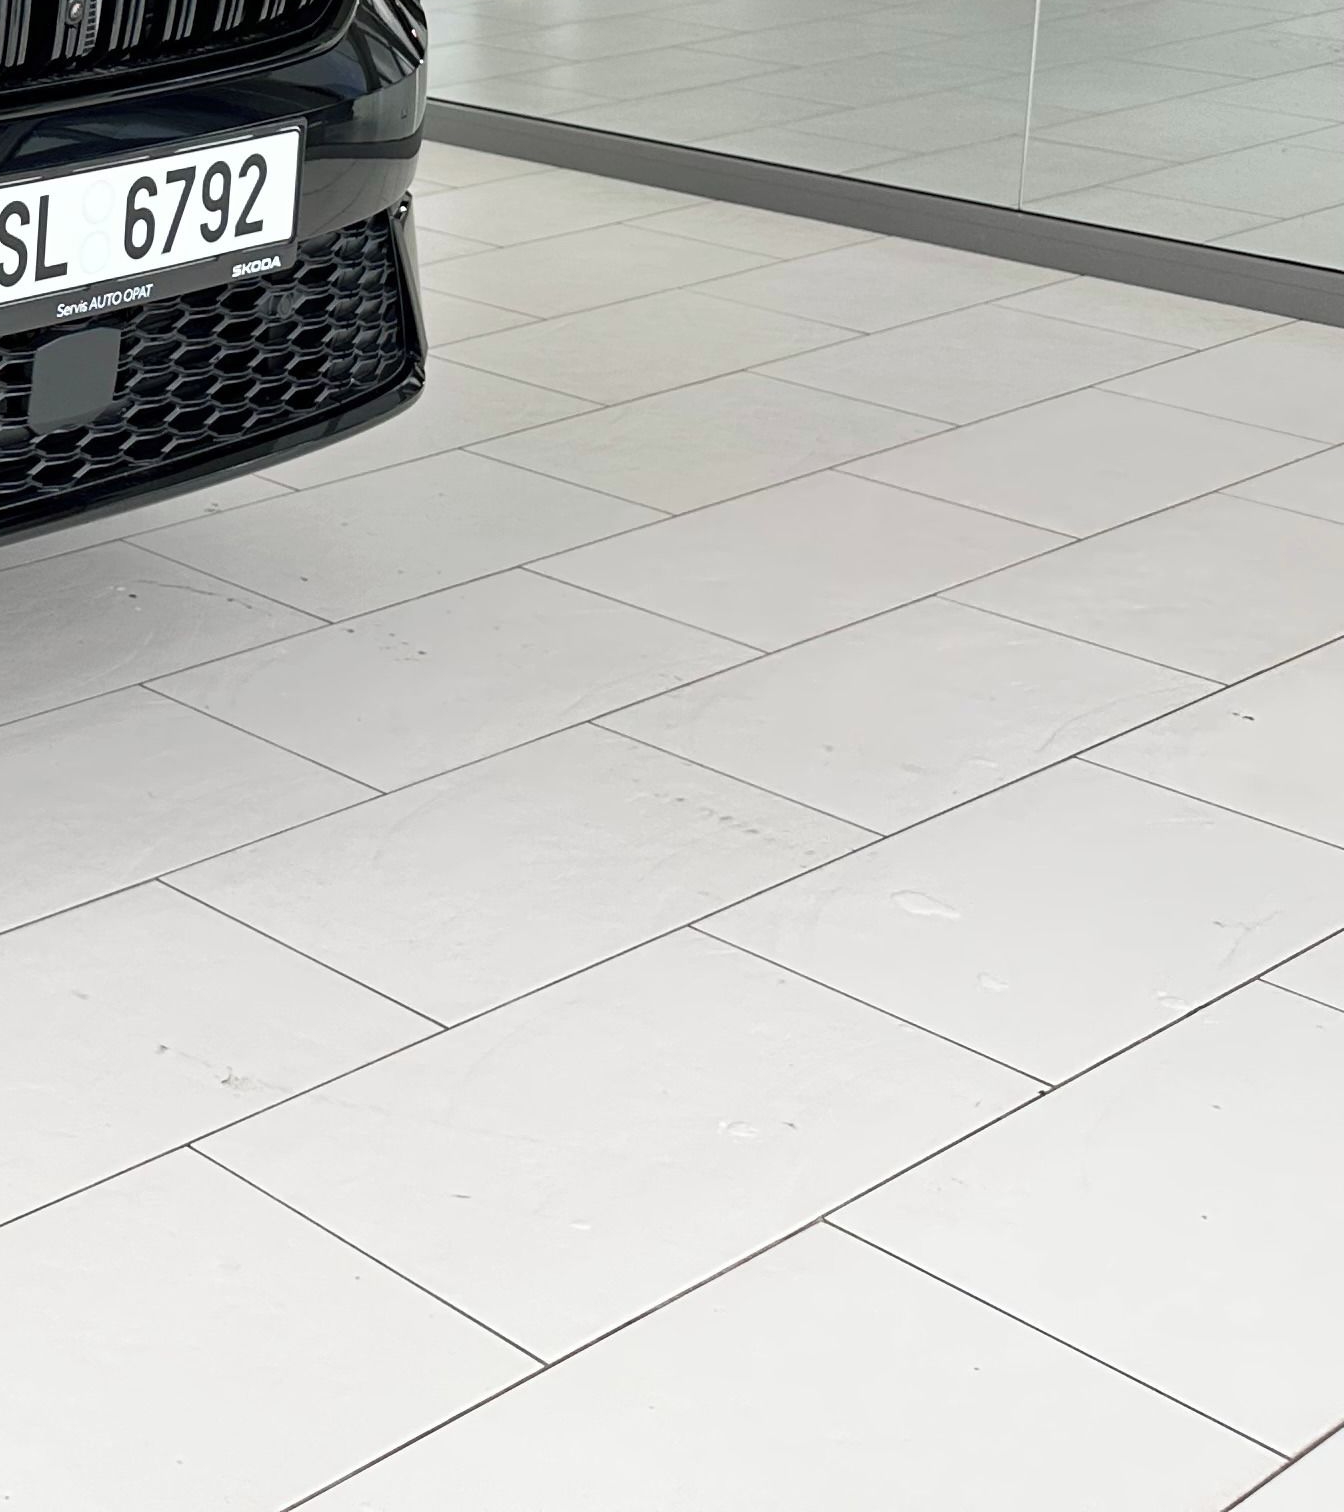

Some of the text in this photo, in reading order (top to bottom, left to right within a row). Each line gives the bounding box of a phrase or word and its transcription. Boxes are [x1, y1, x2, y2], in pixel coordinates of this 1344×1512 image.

[123, 152, 268, 260] 6792
[56, 283, 154, 318] Servis AUTO OPAT
